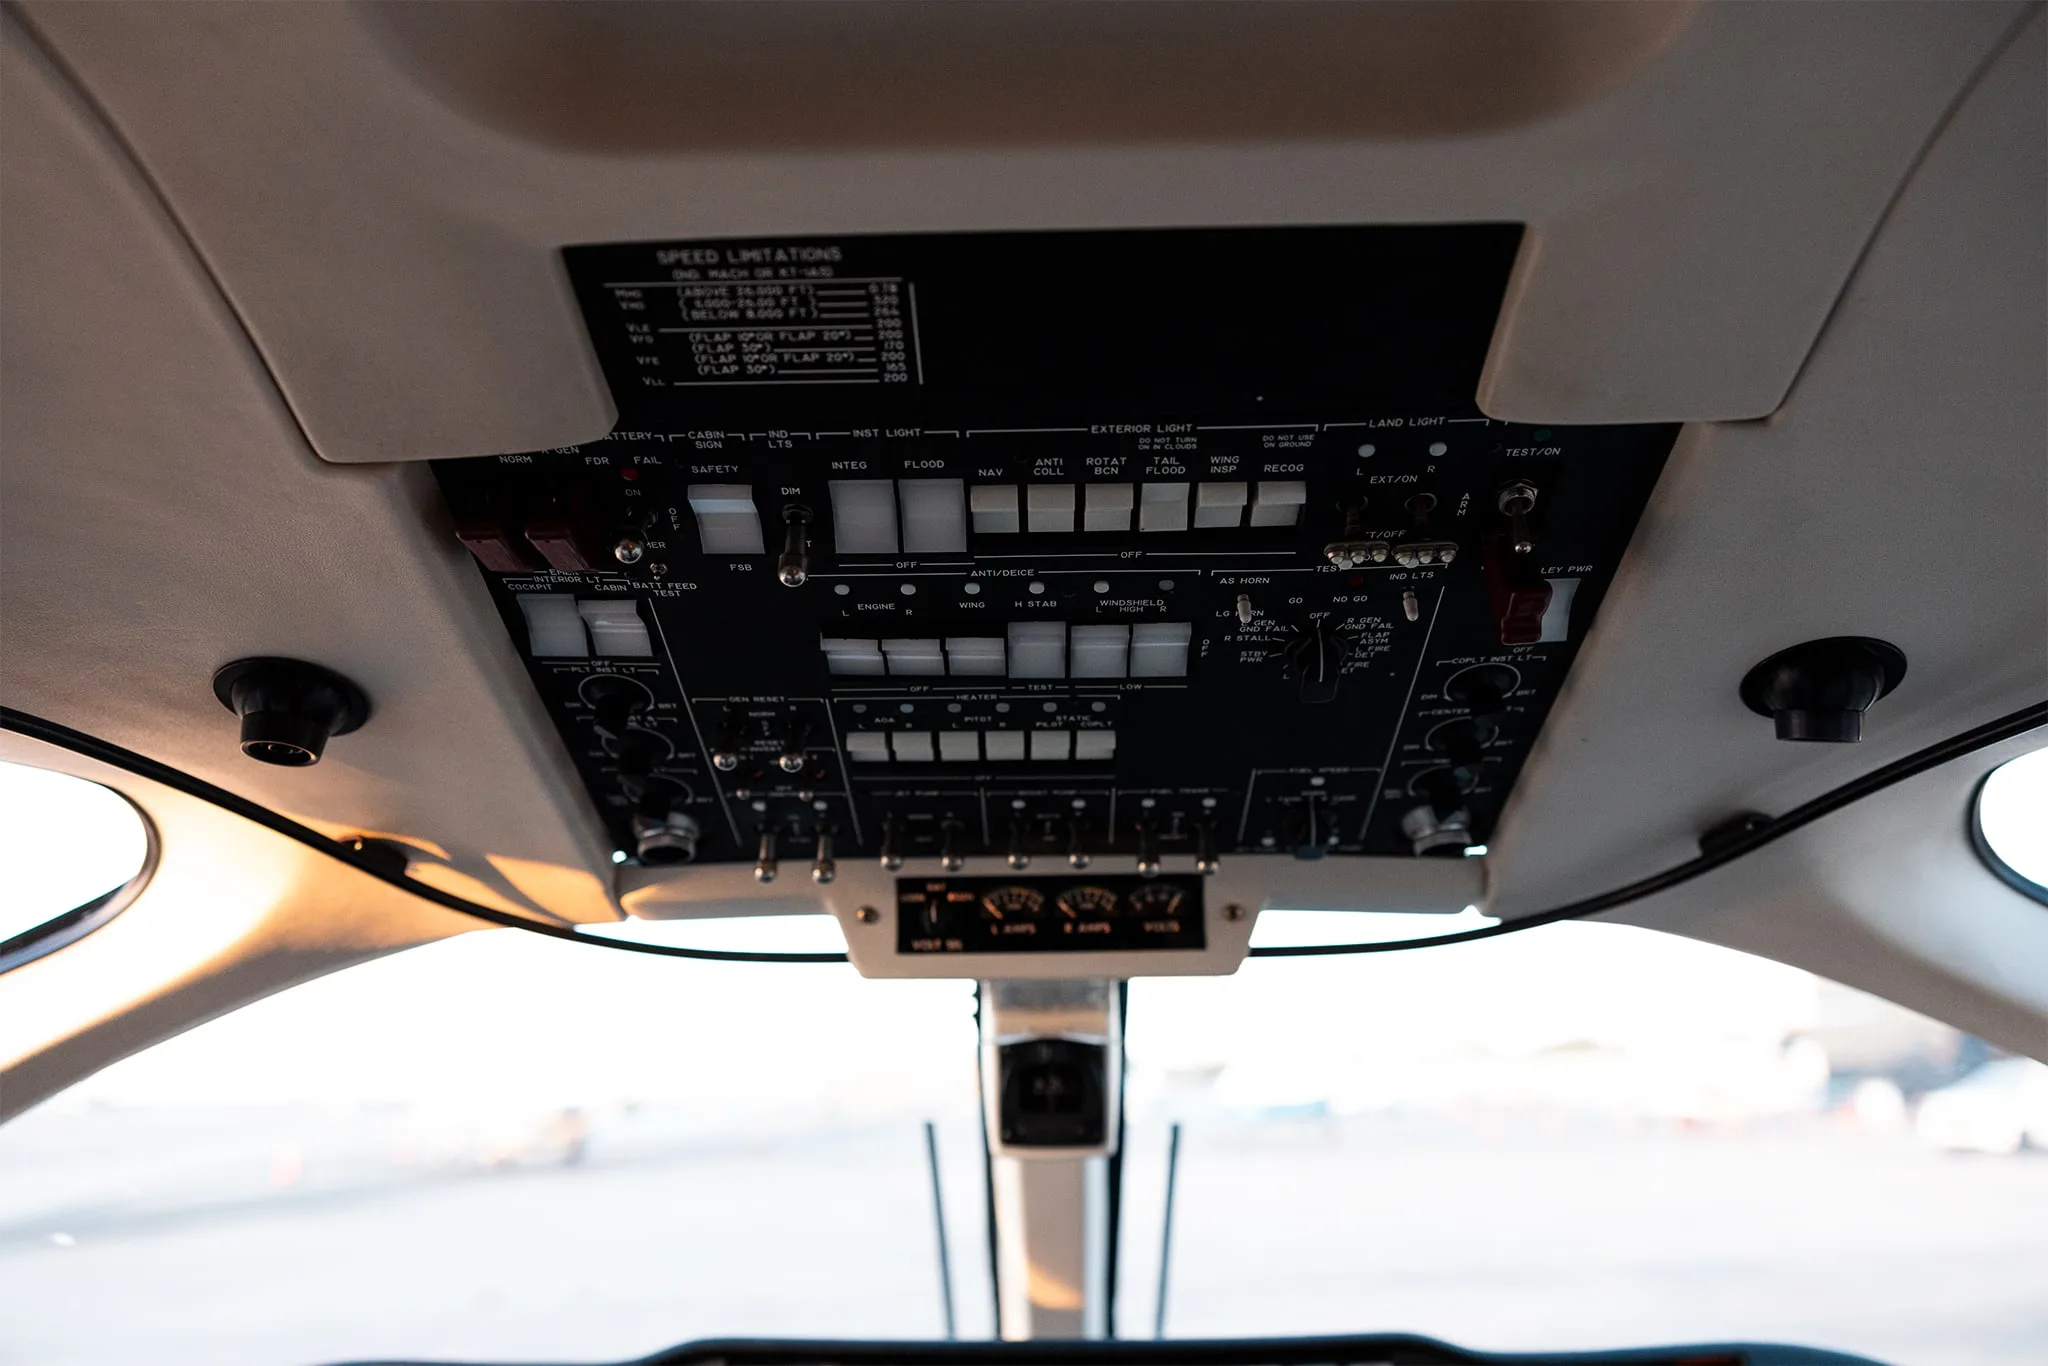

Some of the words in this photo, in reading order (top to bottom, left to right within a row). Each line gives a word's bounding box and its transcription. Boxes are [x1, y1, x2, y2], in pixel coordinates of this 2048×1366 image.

[656, 249, 720, 266] SPEED
[725, 246, 843, 265] LIMITATIONS
[876, 317, 903, 328] 200
[688, 332, 732, 344] (FLAP
[779, 331, 816, 342] FLAP
[878, 329, 904, 340] 200
[691, 342, 735, 354] (FLAP
[694, 354, 738, 366] (FLAP
[783, 352, 820, 364] FLAP
[880, 351, 906, 362] 200
[697, 364, 740, 376] (FLAP
[883, 372, 909, 383] 200
[1368, 418, 1404, 428] LAND
[1409, 416, 1446, 426] LIGHT
[852, 429, 879, 438] INST
[885, 428, 921, 438] LIGHT
[1091, 425, 1151, 435] EXTERIOR
[1156, 424, 1193, 434] LIGHT
[602, 431, 653, 441] ATTERY
[687, 431, 725, 440] CABIN
[768, 430, 788, 439] IND
[695, 440, 723, 449] SIGN
[768, 440, 793, 448] LTS
[1278, 440, 1312, 448] GROUND
[1505, 447, 1562, 457] TEST/ON
[499, 455, 532, 465] NORM
[585, 456, 610, 466] FDR
[633, 455, 663, 465] FAIL
[1035, 458, 1064, 466] ANTI
[1085, 457, 1127, 466] ROTAT
[1153, 456, 1180, 465] TAIL
[1210, 455, 1240, 464] WING
[831, 461, 868, 470] INTEG
[904, 460, 945, 469] FLOOD
[1210, 464, 1237, 473] INSP
[1263, 464, 1305, 473] RECOG
[691, 464, 739, 475] SAFETY
[978, 468, 1004, 477] NAV
[1033, 467, 1065, 476] COLL
[1094, 467, 1119, 475] BCN
[1145, 466, 1186, 475] FLOOD
[1356, 467, 1365, 476] L
[1427, 465, 1436, 474] R
[1370, 475, 1418, 484] EXT/ON
[625, 488, 641, 497] ON
[781, 487, 801, 496] DIM
[1120, 551, 1143, 559] OFF
[729, 563, 753, 572] FSB
[895, 561, 917, 569] OFF
[1567, 564, 1593, 573] PWR
[970, 569, 1035, 577] ANTI/DEICE
[1389, 572, 1409, 580] IND
[1412, 570, 1435, 579] LTS
[532, 575, 583, 583] INTERIOR
[586, 576, 600, 584] LT
[1219, 577, 1235, 585] AS
[1239, 577, 1270, 585] HORN
[507, 583, 553, 591] COCKPIT
[594, 583, 628, 592] CABIN
[632, 582, 662, 590] BATT
[668, 582, 698, 590] FEED
[653, 589, 681, 597] TEST
[1353, 595, 1368, 603] GO
[1215, 610, 1230, 618] LG
[1309, 612, 1330, 620] OFF
[1370, 622, 1395, 630] FAIL
[1236, 634, 1272, 642] STALL
[1452, 656, 1485, 665] COPLT
